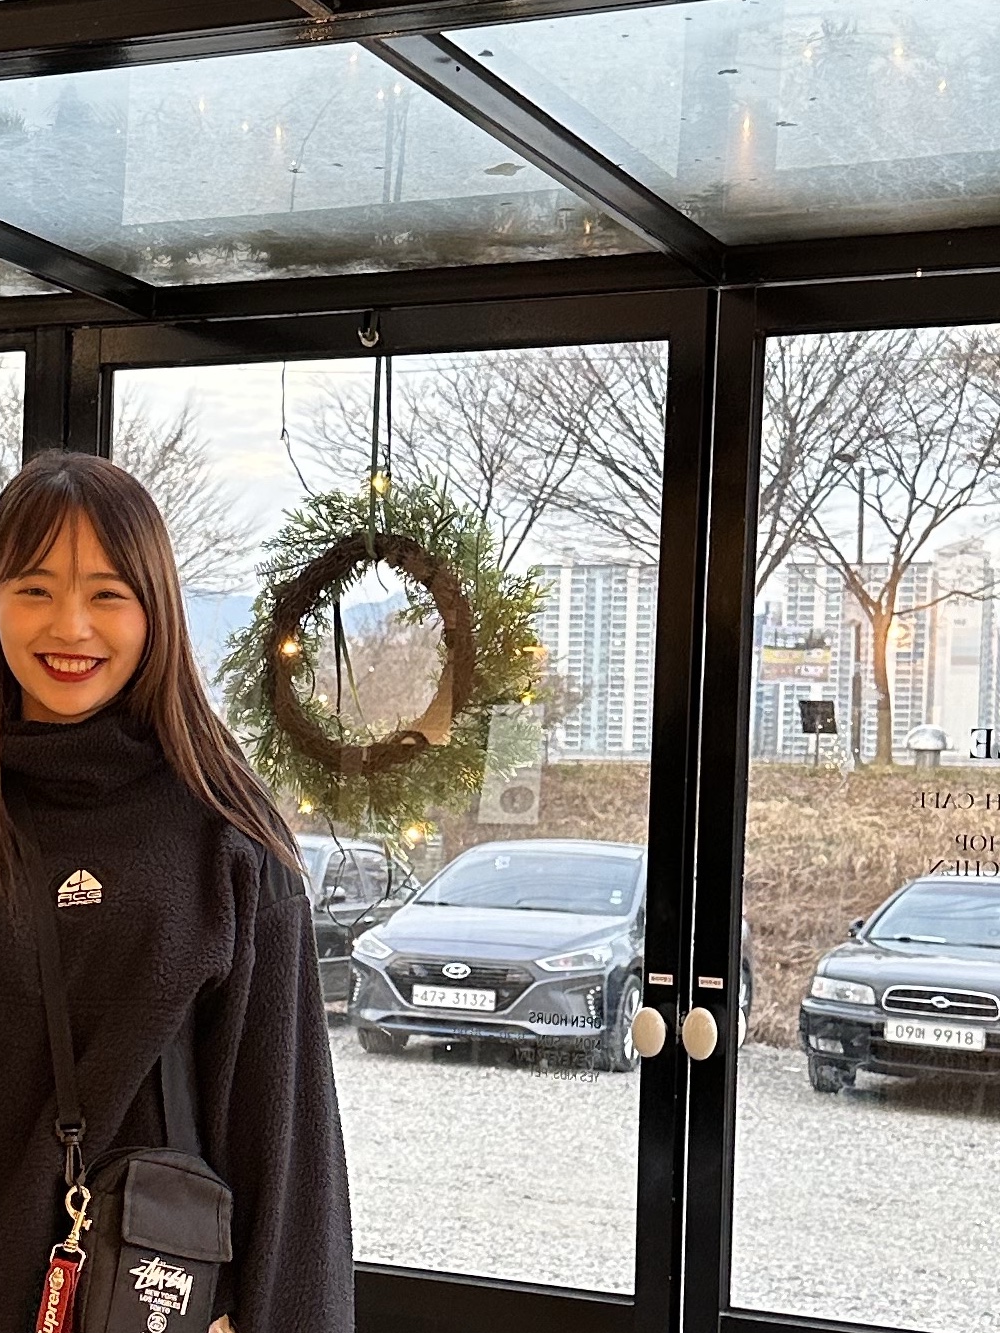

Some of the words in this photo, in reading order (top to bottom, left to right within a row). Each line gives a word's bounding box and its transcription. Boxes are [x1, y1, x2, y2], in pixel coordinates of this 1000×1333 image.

[57, 890, 102, 903] ACG
[452, 992, 487, 1007] 3132
[933, 1028, 974, 1045] 9918
[139, 1293, 153, 1304] LOS
